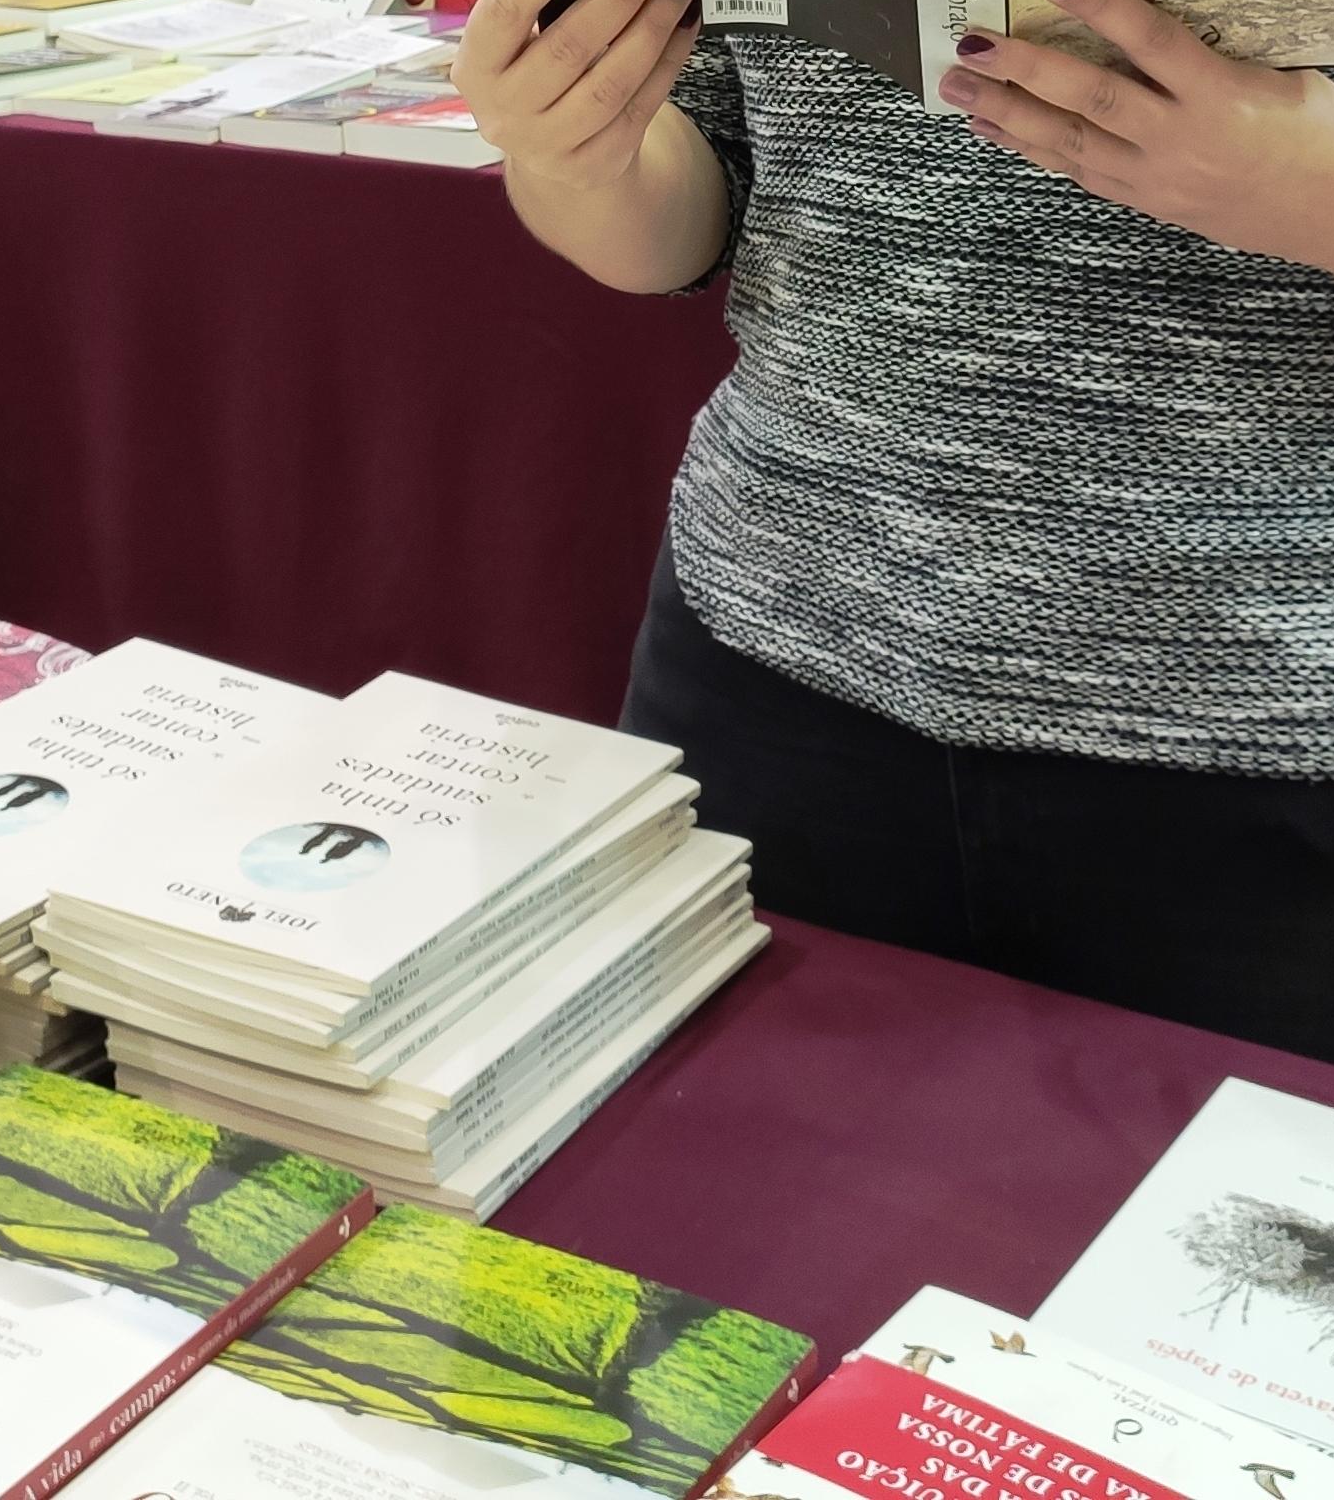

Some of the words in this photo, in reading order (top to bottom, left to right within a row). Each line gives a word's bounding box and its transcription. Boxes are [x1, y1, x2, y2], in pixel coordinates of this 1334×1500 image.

[141, 681, 254, 730] história
[51, 715, 185, 763] saudades
[120, 709, 220, 745] contar
[419, 720, 553, 771] história
[27, 734, 106, 774] tinha
[111, 760, 147, 785] só
[405, 748, 521, 786] contar
[319, 778, 410, 822] tinha
[334, 753, 493, 806] saudades
[419, 806, 462, 830] só
[165, 881, 230, 907] NETO
[261, 902, 323, 933] JOEL
[1145, 1337, 1222, 1378] Papéis
[1226, 1366, 1260, 1387] de
[38, 1446, 85, 1489] vida
[107, 1369, 178, 1435] campo:
[1112, 1391, 1180, 1429] QUETZAL
[897, 1411, 1001, 1471] NOSSA
[1002, 1464, 1057, 1496] DE
[922, 1392, 1050, 1458] FÁTIMA
[1048, 1452, 1101, 1487] DE
[918, 1456, 988, 1498] DAS
